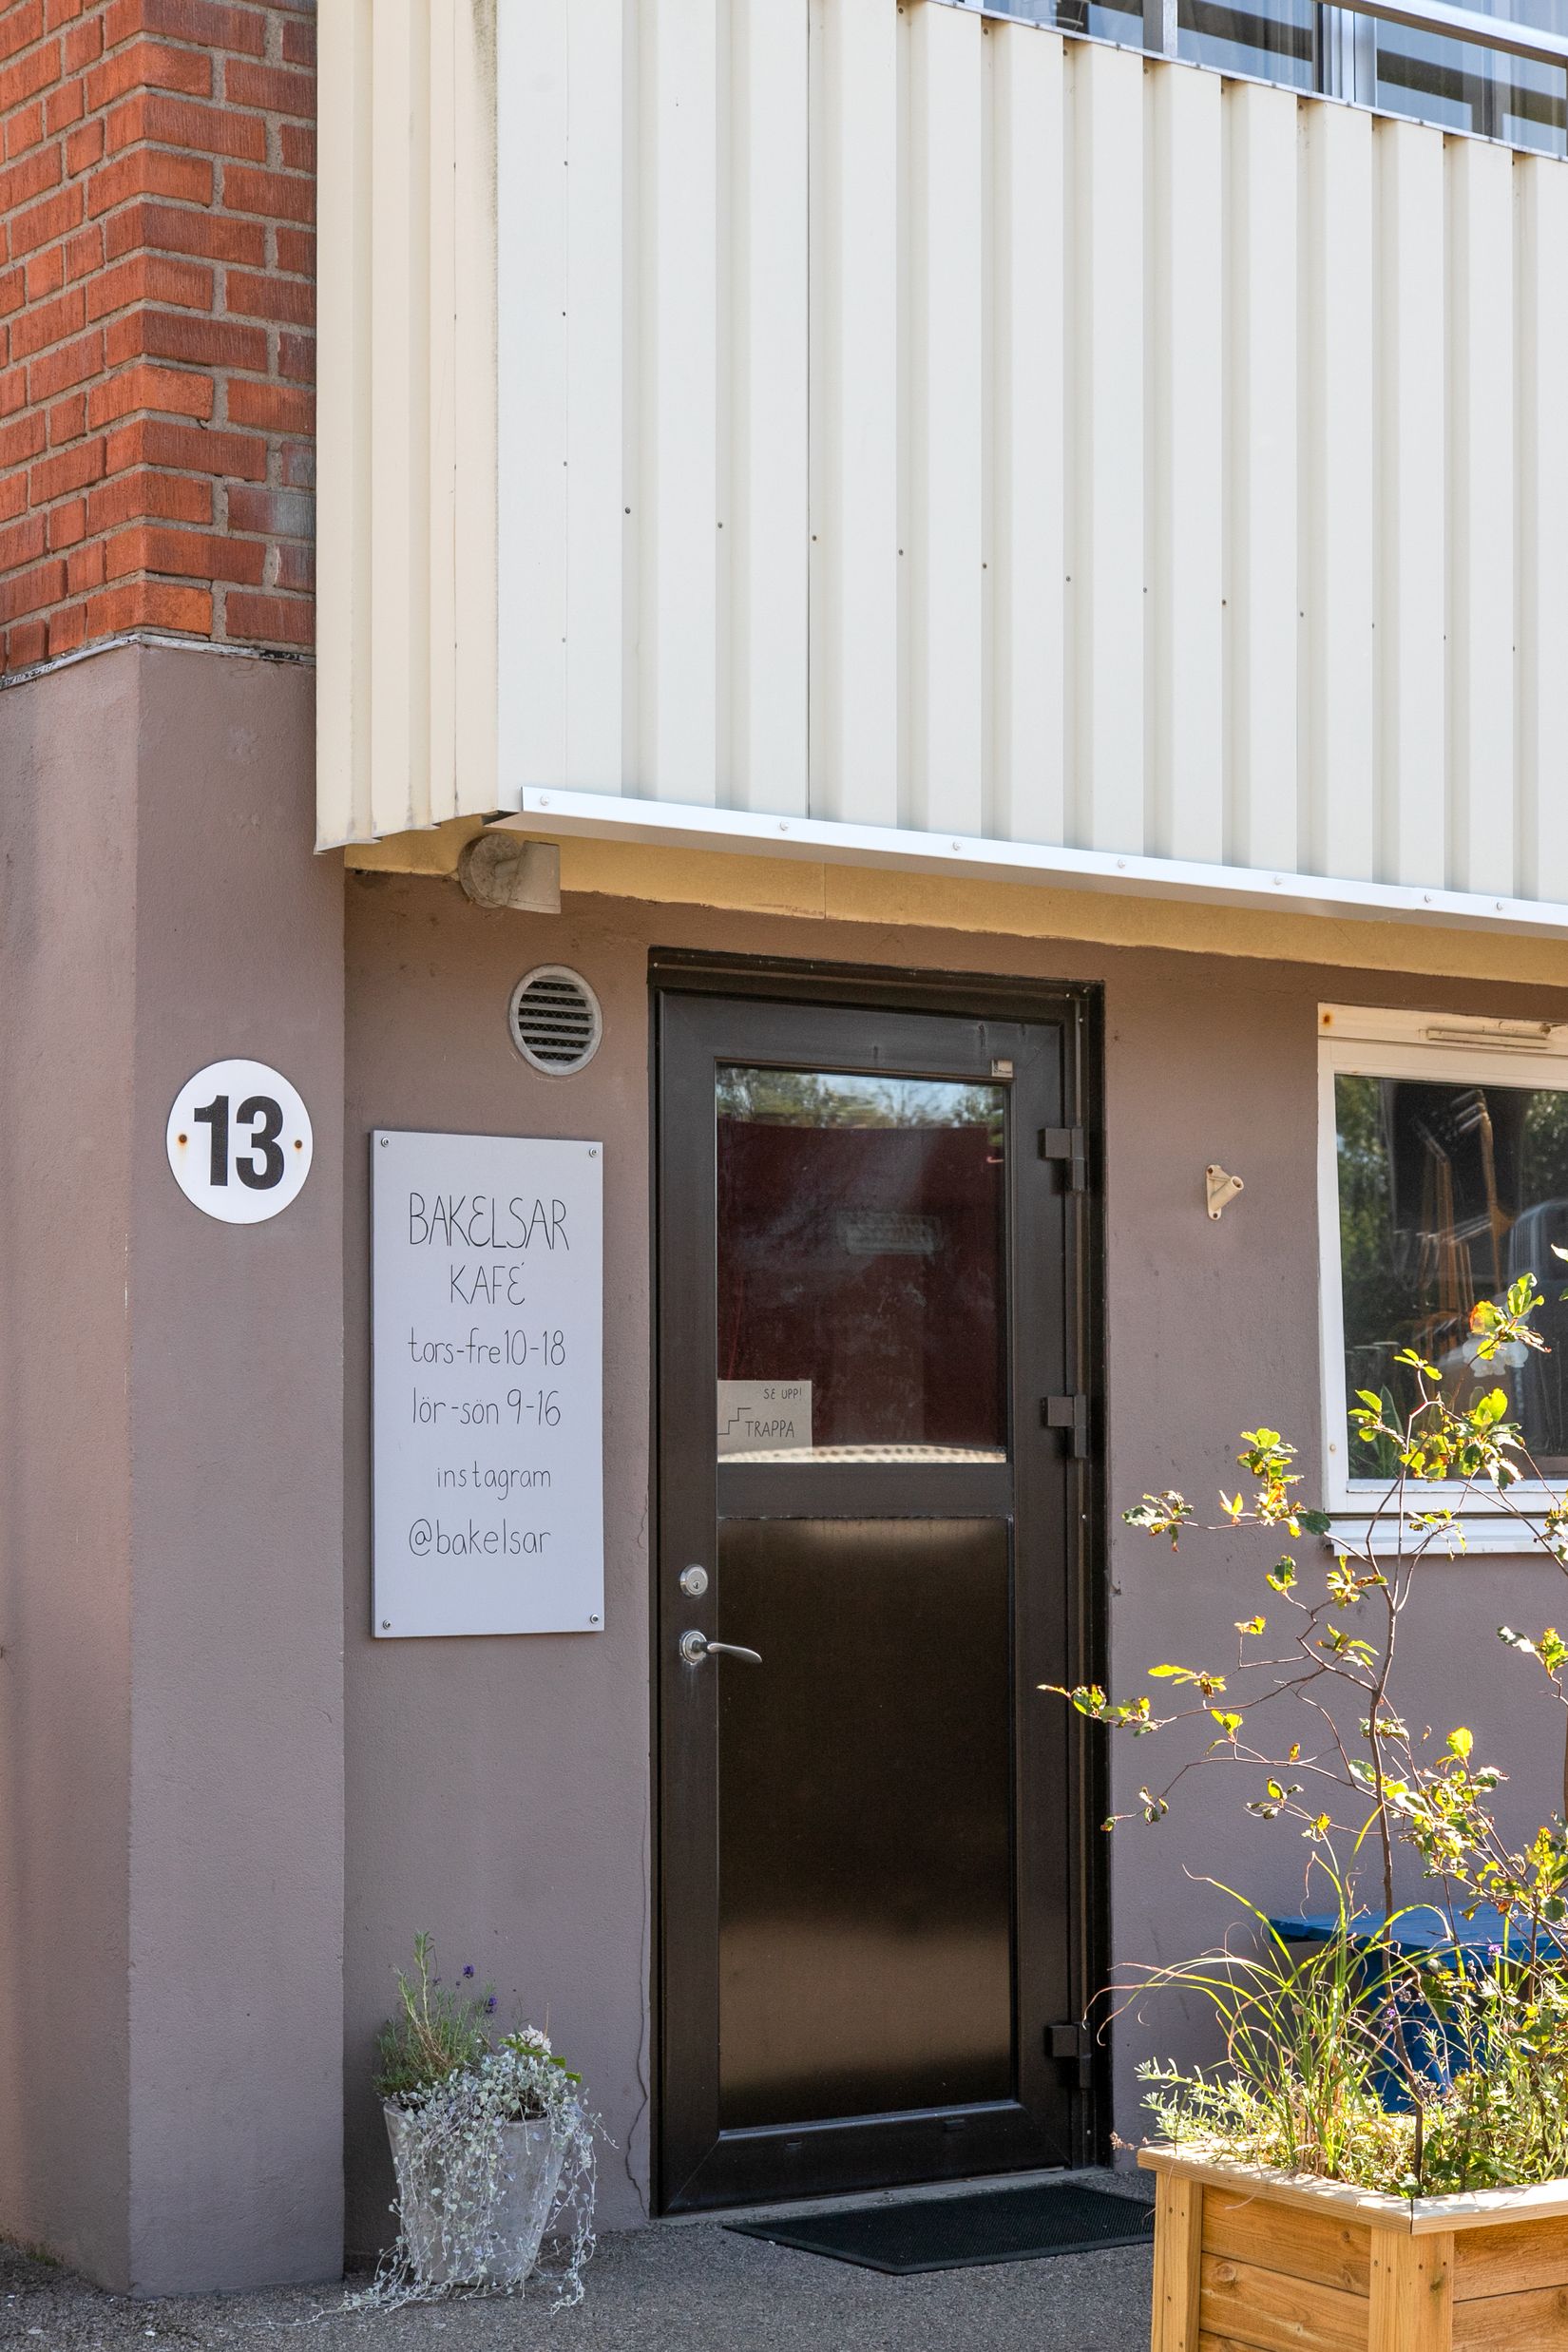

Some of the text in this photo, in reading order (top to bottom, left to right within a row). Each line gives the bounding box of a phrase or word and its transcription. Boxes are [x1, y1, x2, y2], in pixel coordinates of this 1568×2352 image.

[194, 1095, 284, 1190] 13
[410, 1192, 569, 1251] BAKELSAR
[450, 1261, 526, 1306] KAFÉ
[507, 1388, 561, 1426] 9-16
[763, 1387, 802, 1401] SE UPP!
[745, 1420, 794, 1438] TRAPPA
[436, 1460, 551, 1501] instagram
[409, 1518, 552, 1557] @bakelsar
